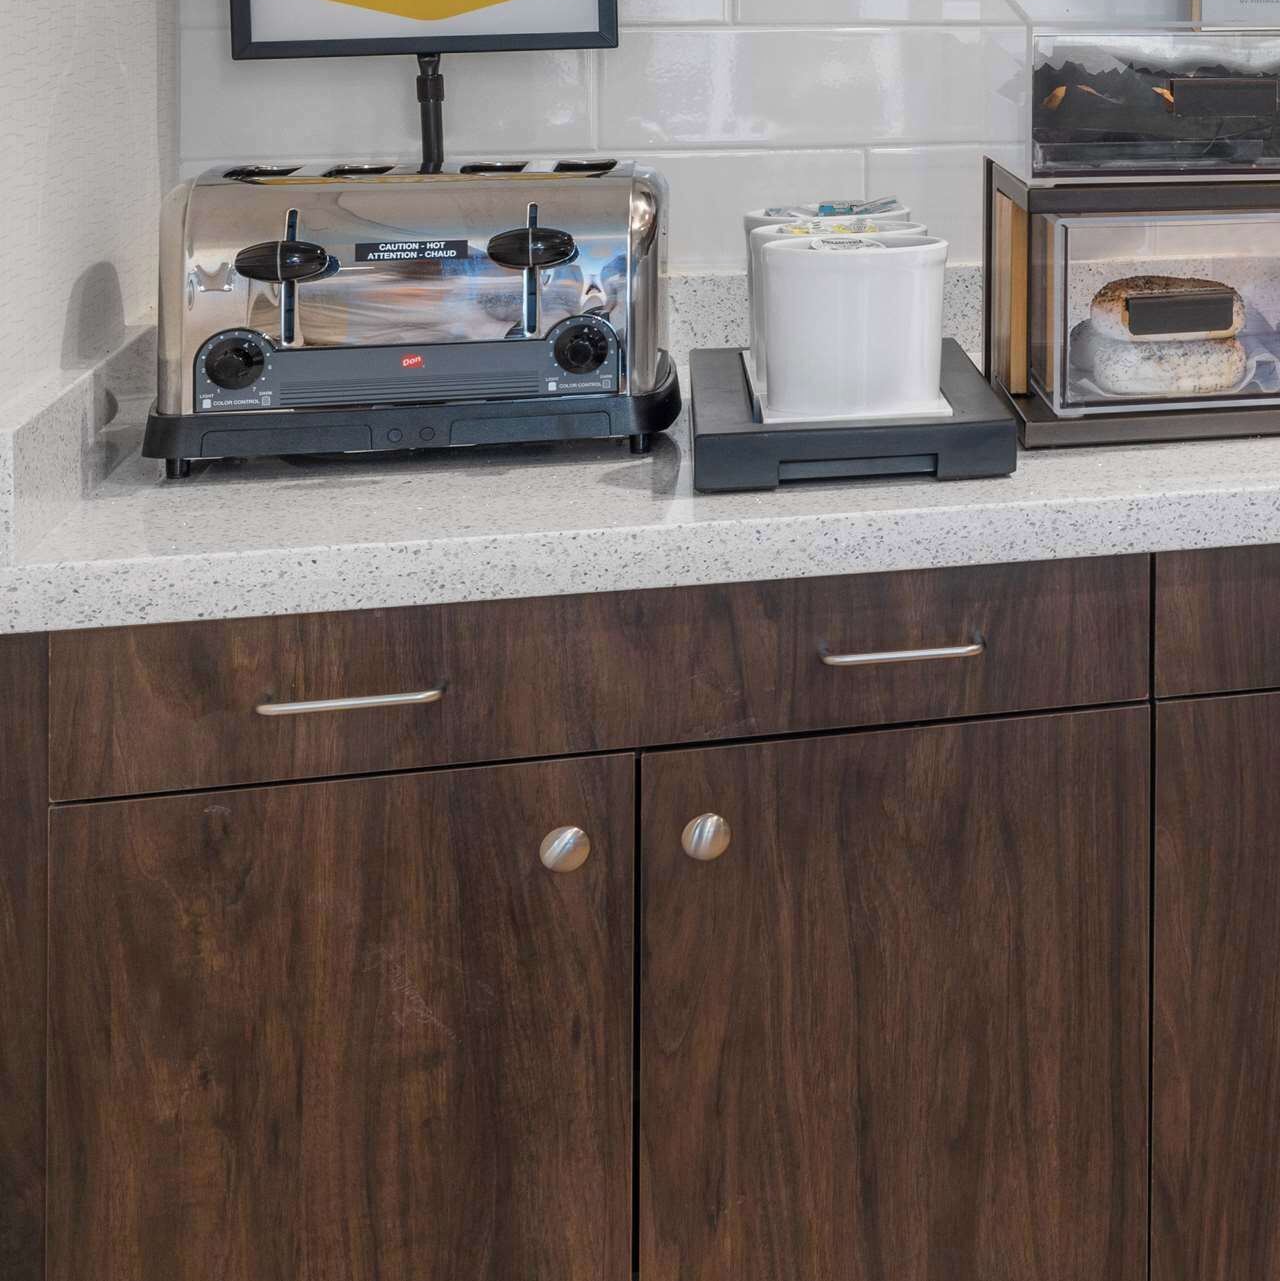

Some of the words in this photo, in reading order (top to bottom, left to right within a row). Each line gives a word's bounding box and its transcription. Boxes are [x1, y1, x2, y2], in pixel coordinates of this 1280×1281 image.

[379, 243, 419, 251] CAUTION
[426, 241, 445, 249] HOT
[367, 251, 417, 260] ATTENTION
[425, 250, 456, 258] CHAUD
